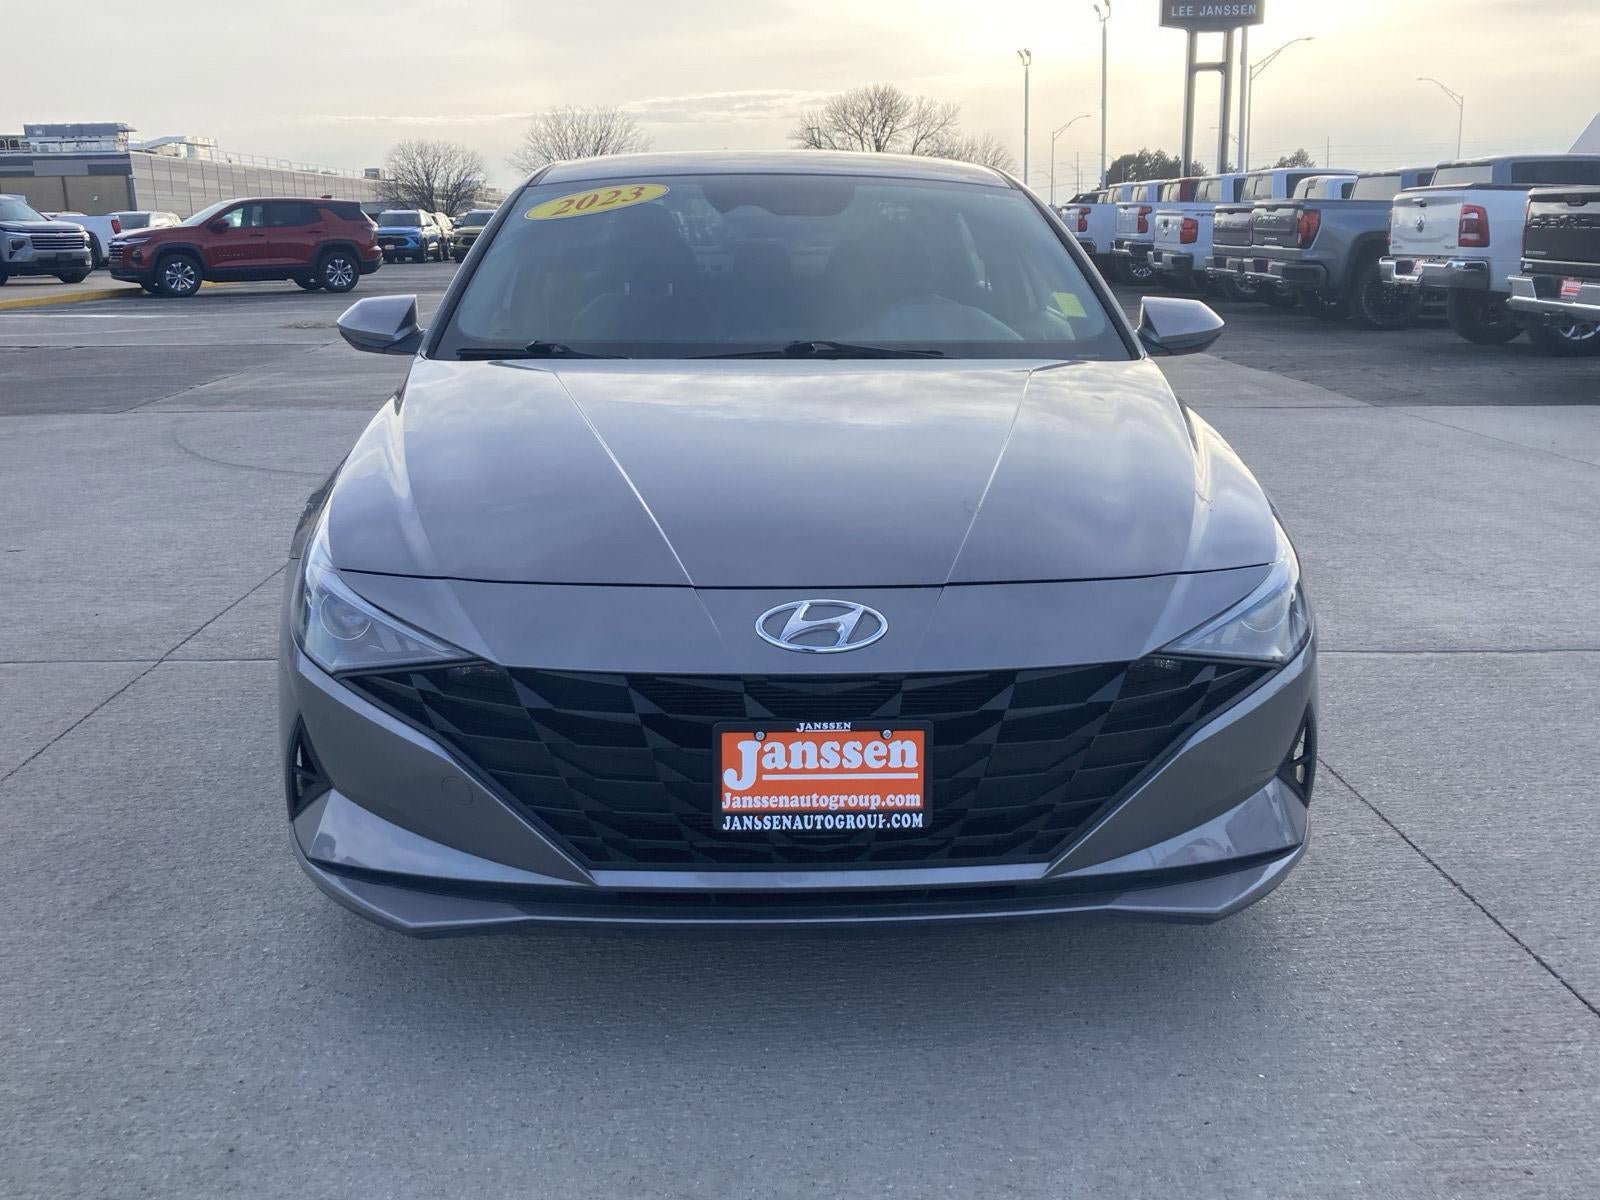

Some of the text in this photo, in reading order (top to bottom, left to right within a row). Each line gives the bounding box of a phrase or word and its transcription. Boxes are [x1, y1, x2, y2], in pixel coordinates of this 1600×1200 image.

[1171, 5, 1256, 16] LEE JANSSEN
[551, 186, 645, 216] 2023
[796, 722, 851, 732] JANSSEN
[723, 740, 918, 790] Janssen
[722, 793, 920, 810] Janssenautogroup.com
